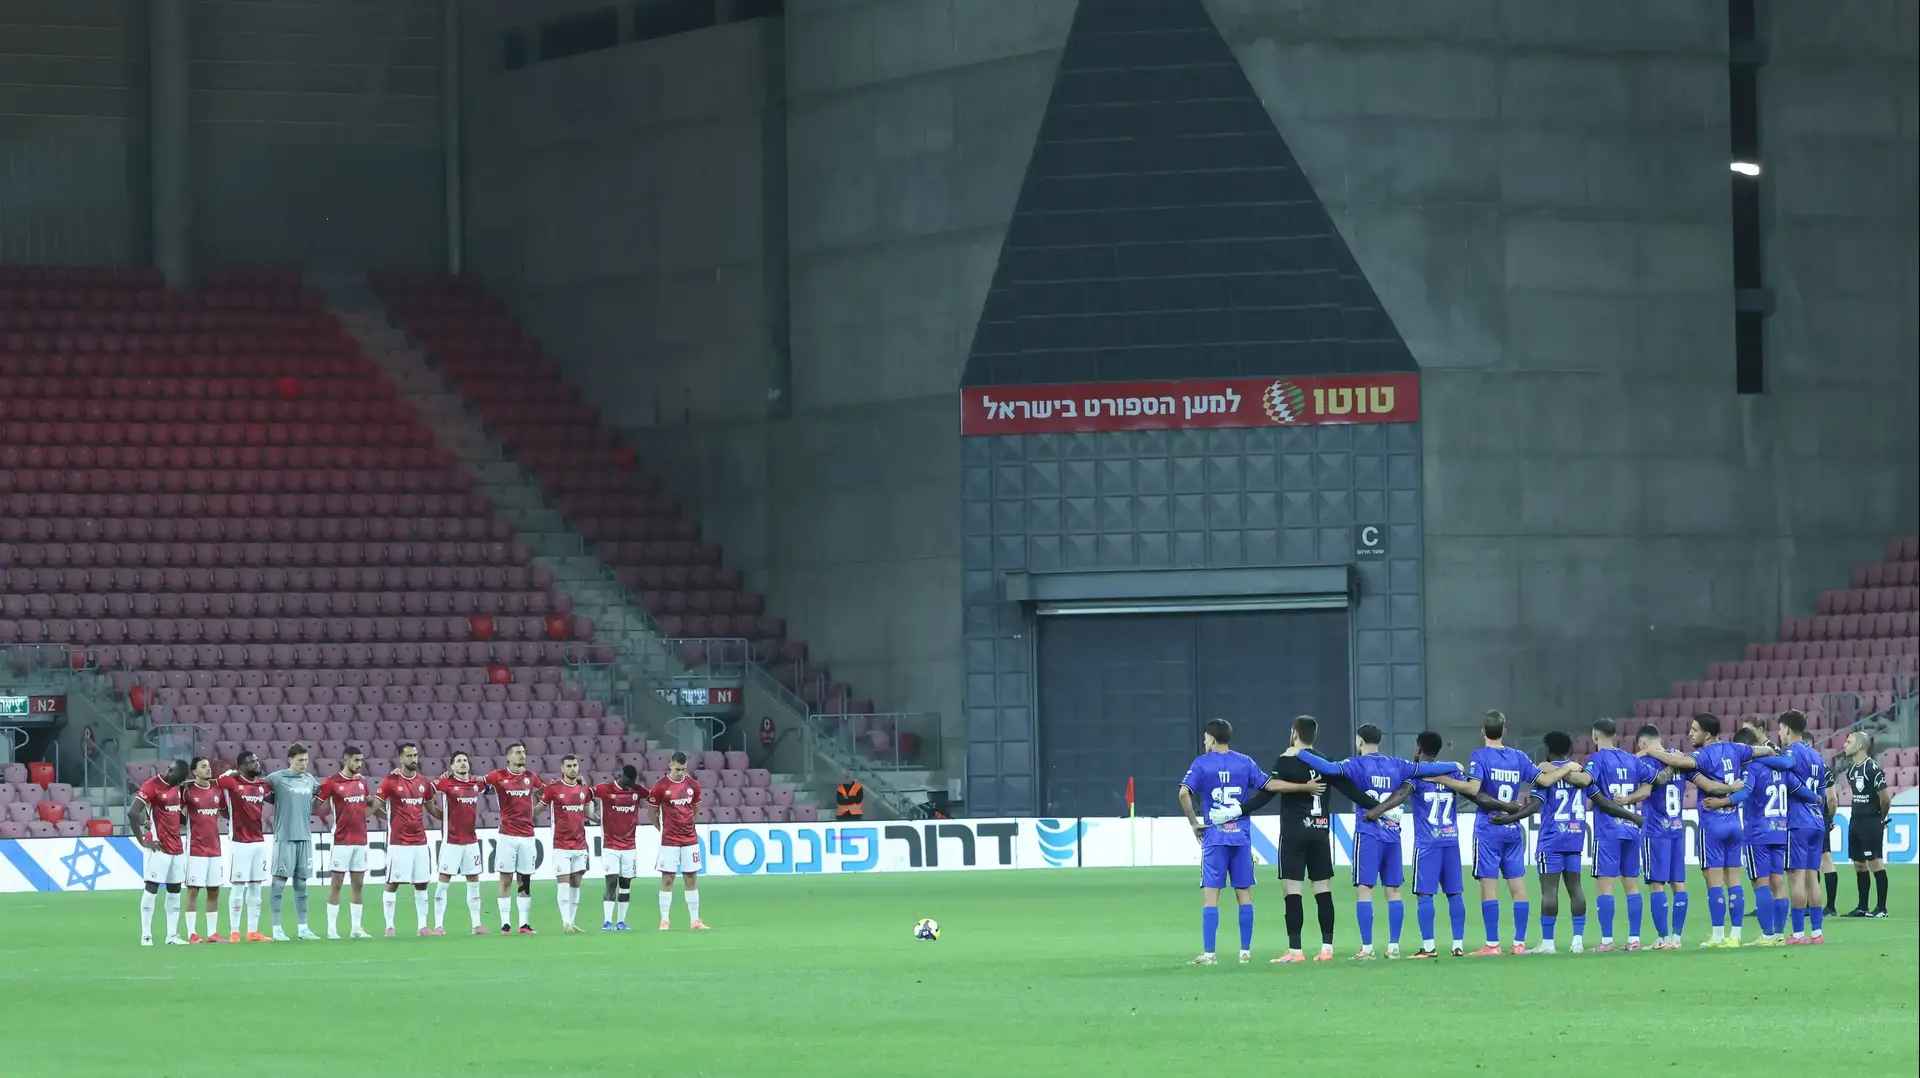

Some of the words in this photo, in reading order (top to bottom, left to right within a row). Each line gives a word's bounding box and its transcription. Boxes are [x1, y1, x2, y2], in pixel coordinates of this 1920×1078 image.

[983, 395, 1078, 420] בישראל
[1084, 396, 1175, 417] הספורט
[1182, 387, 1242, 420] למען
[1313, 386, 1395, 415] טוטו
[1362, 526, 1379, 547] C
[37, 699, 56, 712] N2
[717, 690, 732, 703] N1
[1423, 791, 1455, 825] 77
[1554, 789, 1586, 821] 24
[1666, 784, 1682, 818] 8
[1764, 784, 1787, 818] 20
[885, 822, 1018, 868] דרור
